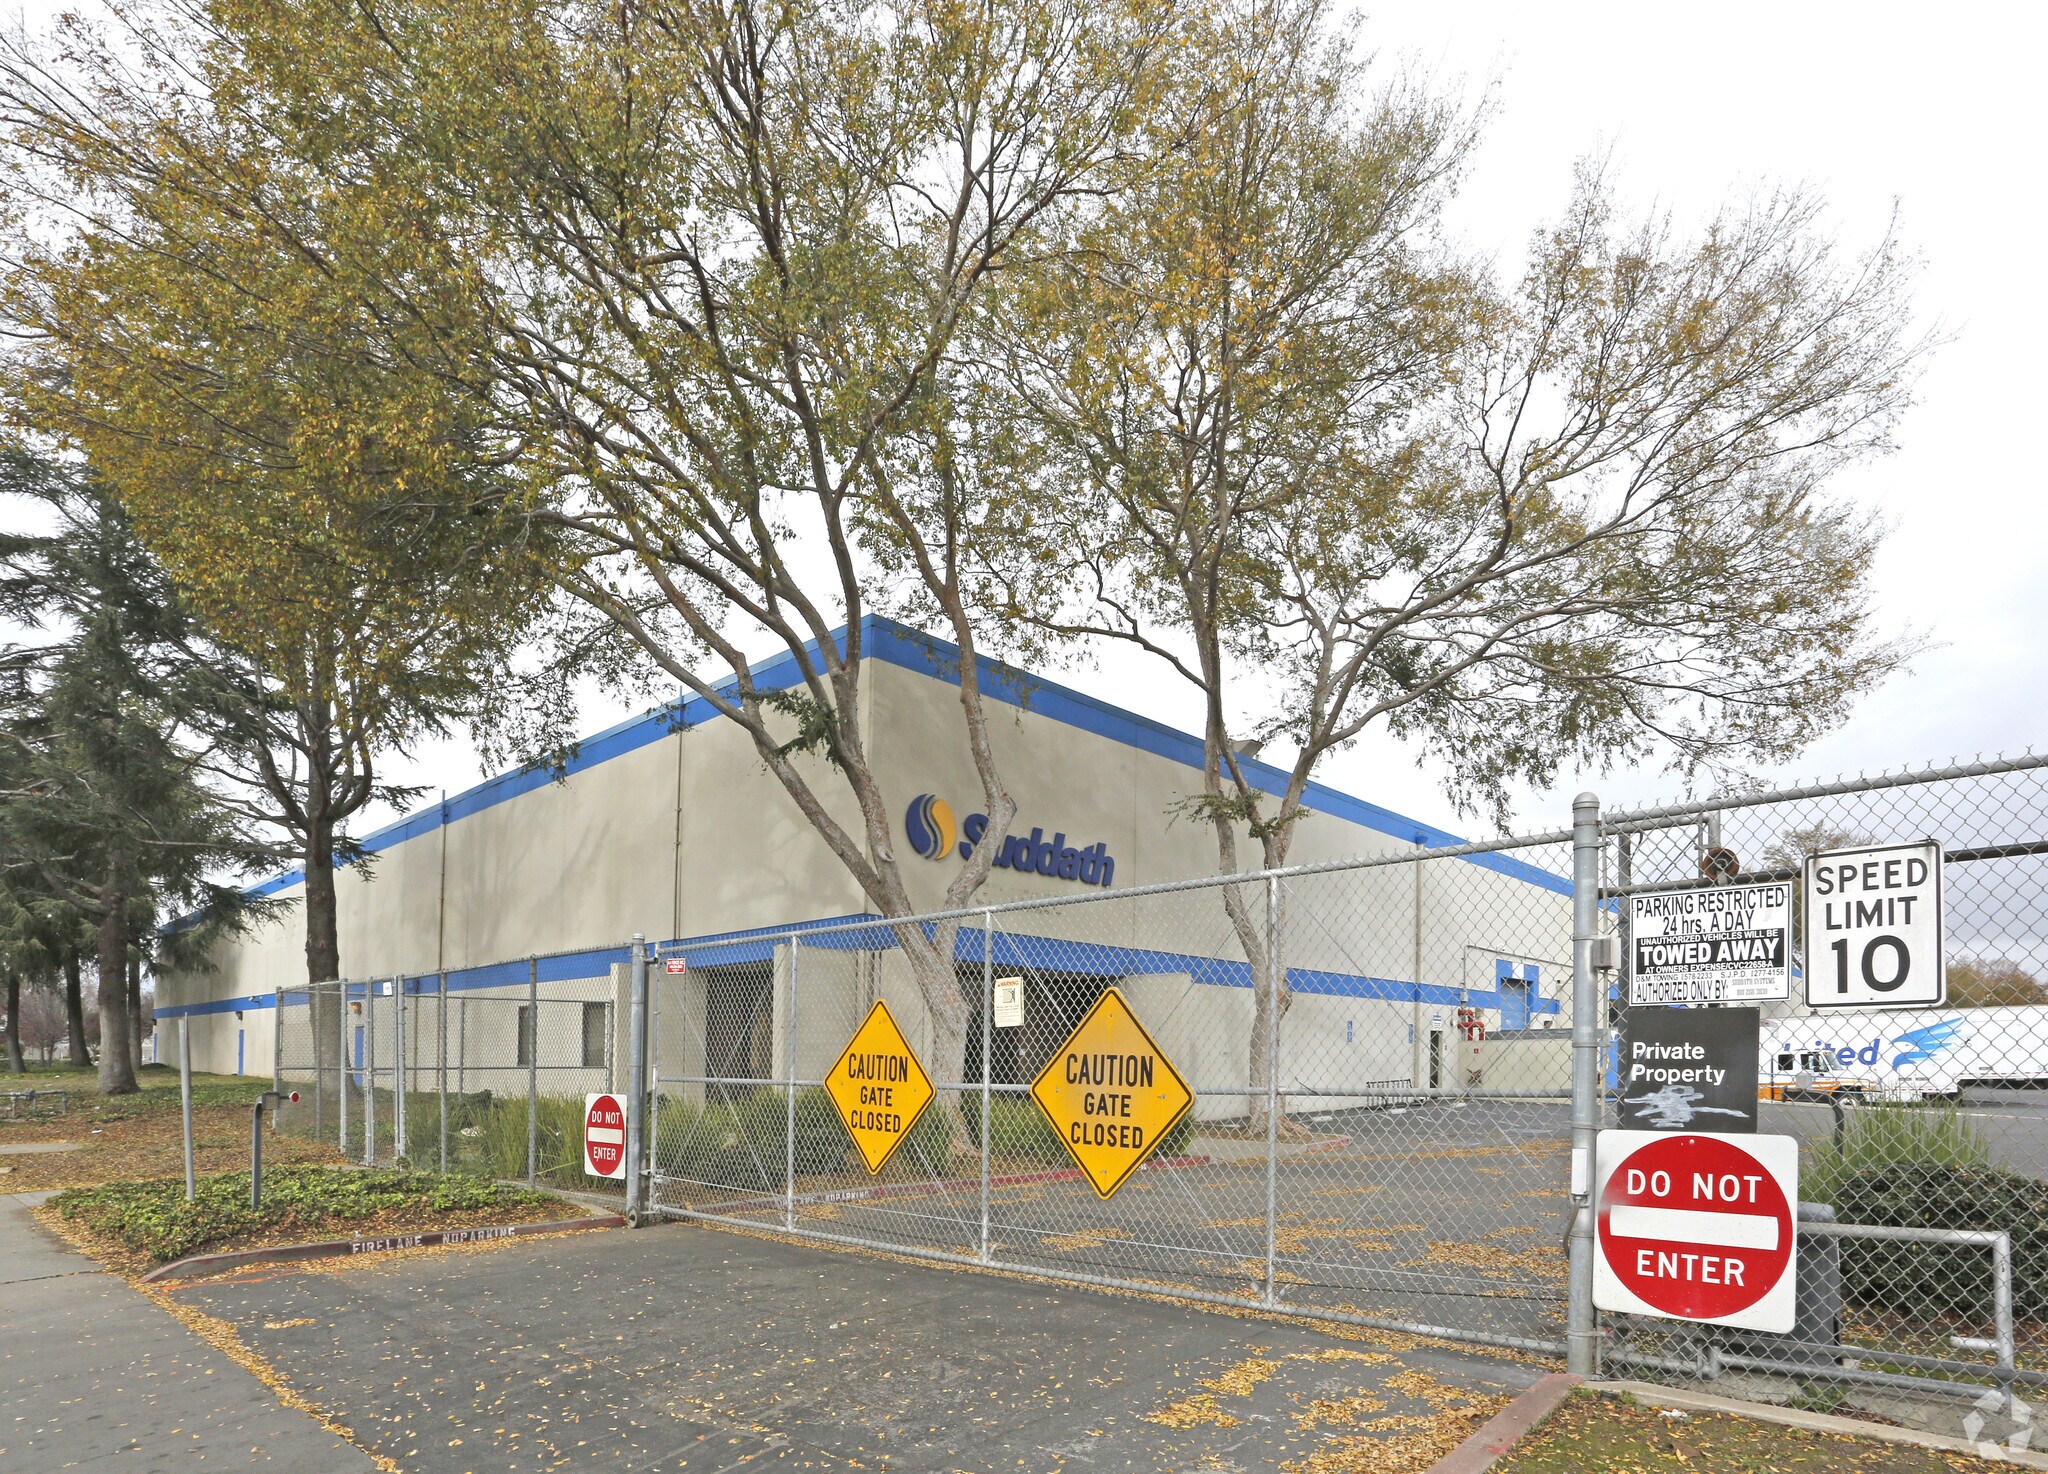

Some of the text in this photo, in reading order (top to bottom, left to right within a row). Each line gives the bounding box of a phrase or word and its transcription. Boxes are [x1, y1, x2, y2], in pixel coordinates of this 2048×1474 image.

[1816, 858, 1928, 895] SPEED
[1636, 887, 1785, 918] PARKING RESTRICTED
[1826, 896, 1918, 930] LIMIT
[1663, 910, 1755, 935] 24 hrs. A DAY
[1640, 929, 1778, 946] UNAUTHORIZED VEHICLES WILL BE
[1640, 938, 1780, 966] TOWED AWAY
[1831, 935, 1911, 993] 10
[1645, 966, 1654, 974] AT
[1655, 964, 1689, 973] OWNERS
[1653, 973, 1679, 982] TOWING
[1636, 981, 1689, 1002] AUTHORIZED
[1691, 980, 1713, 1000] ONLY
[1632, 1042, 1705, 1060] Private
[848, 1052, 908, 1083] CAUTION
[1066, 1053, 1154, 1088] CAUTION
[1632, 1063, 1726, 1086] Property
[860, 1085, 893, 1107] GATE
[1084, 1092, 1132, 1118] GATE
[591, 1110, 621, 1125] DO NOT
[851, 1109, 901, 1133] CLOSED
[1070, 1121, 1143, 1149] CLOSED
[593, 1146, 616, 1161] ENTER
[1627, 1169, 1763, 1203] DO NOT
[1636, 1249, 1745, 1287] ENTER
